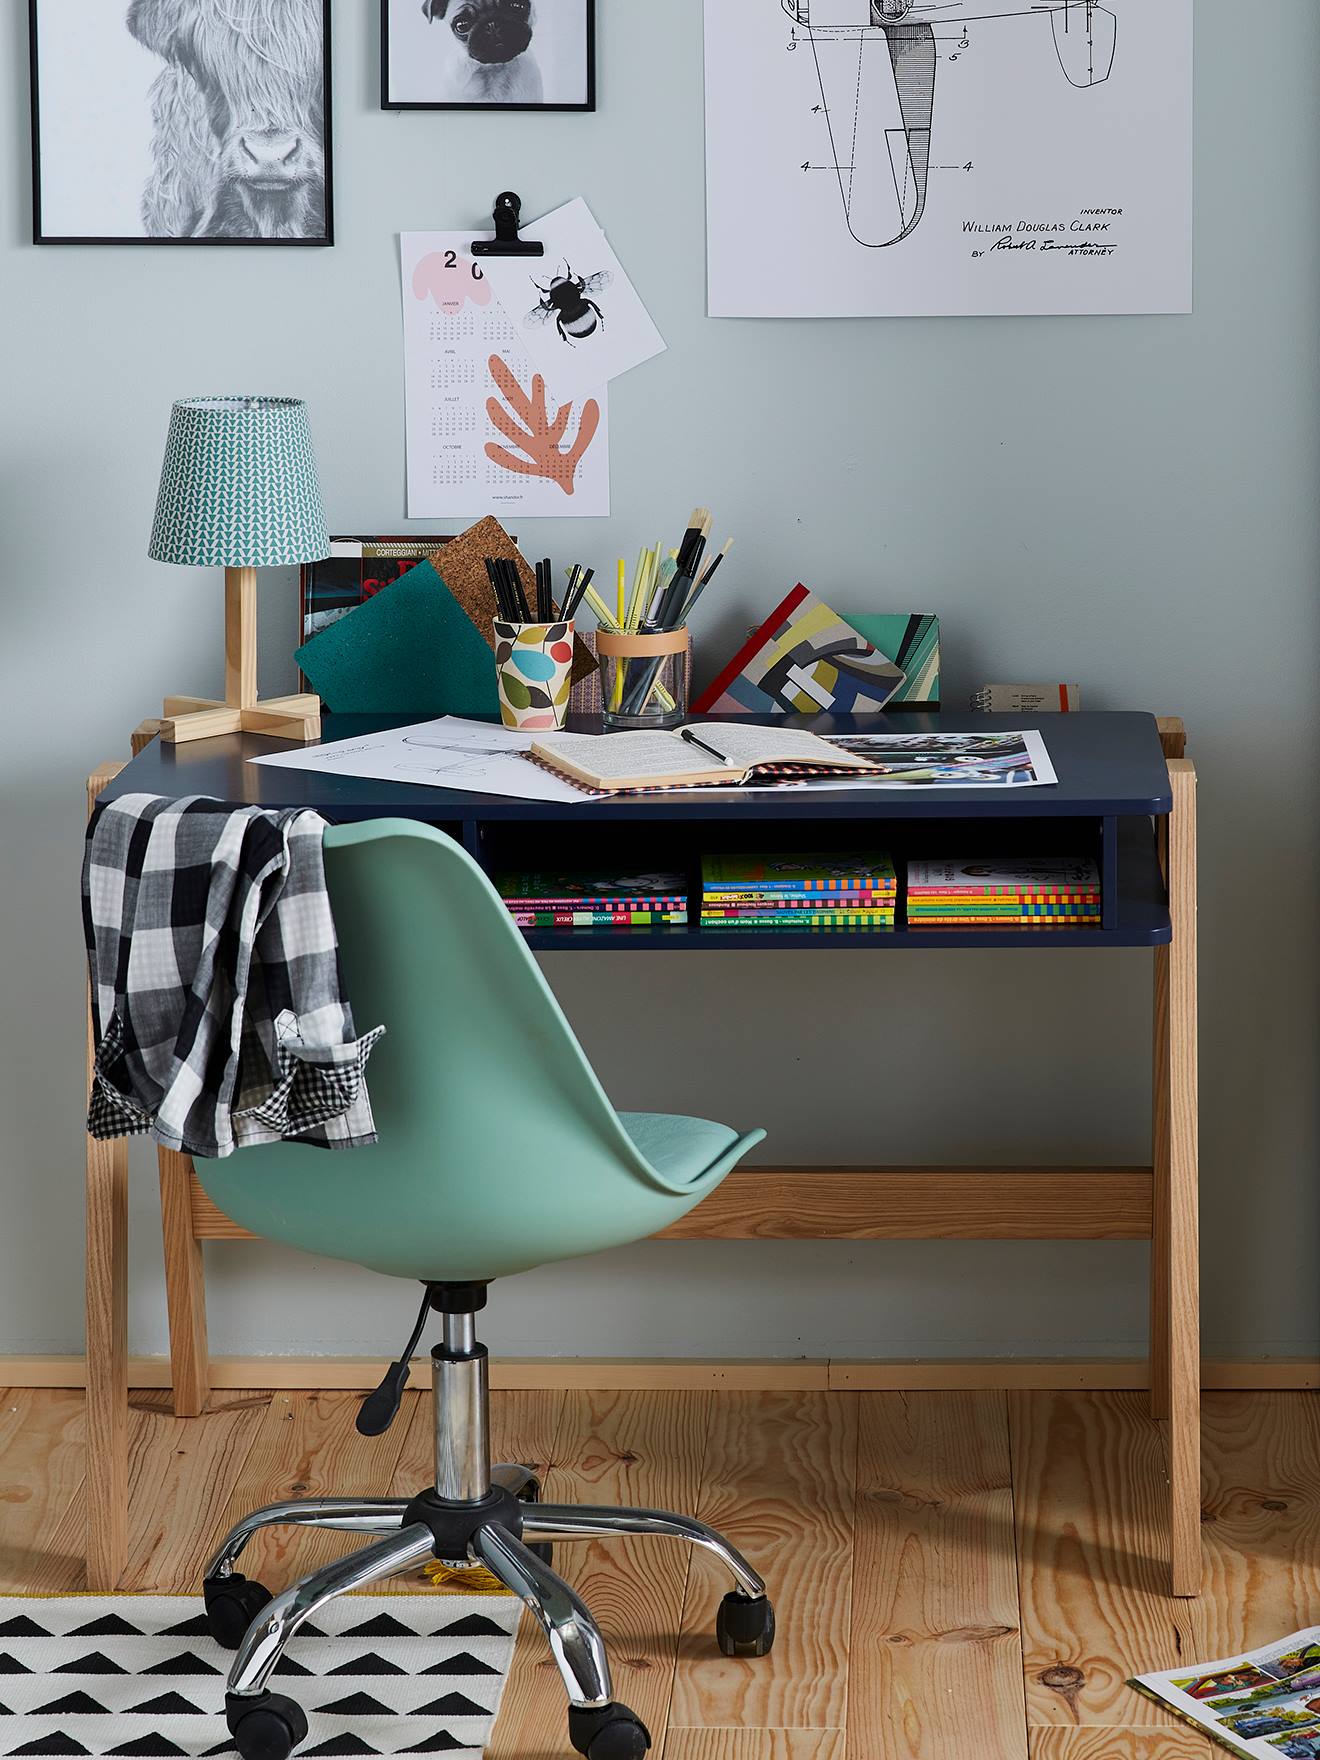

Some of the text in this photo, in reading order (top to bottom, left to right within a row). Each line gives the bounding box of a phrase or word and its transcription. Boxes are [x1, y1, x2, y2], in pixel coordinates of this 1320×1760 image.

[949, 52, 962, 61] 5
[800, 161, 811, 172] 4
[962, 161, 974, 172] 4
[1079, 208, 1123, 216] INVENTOR
[962, 219, 1111, 233] WILLIAM DOUGLAS CLARK
[444, 250, 457, 268] 2
[971, 250, 985, 258] BY
[376, 548, 417, 557] CORTEGGIANI
